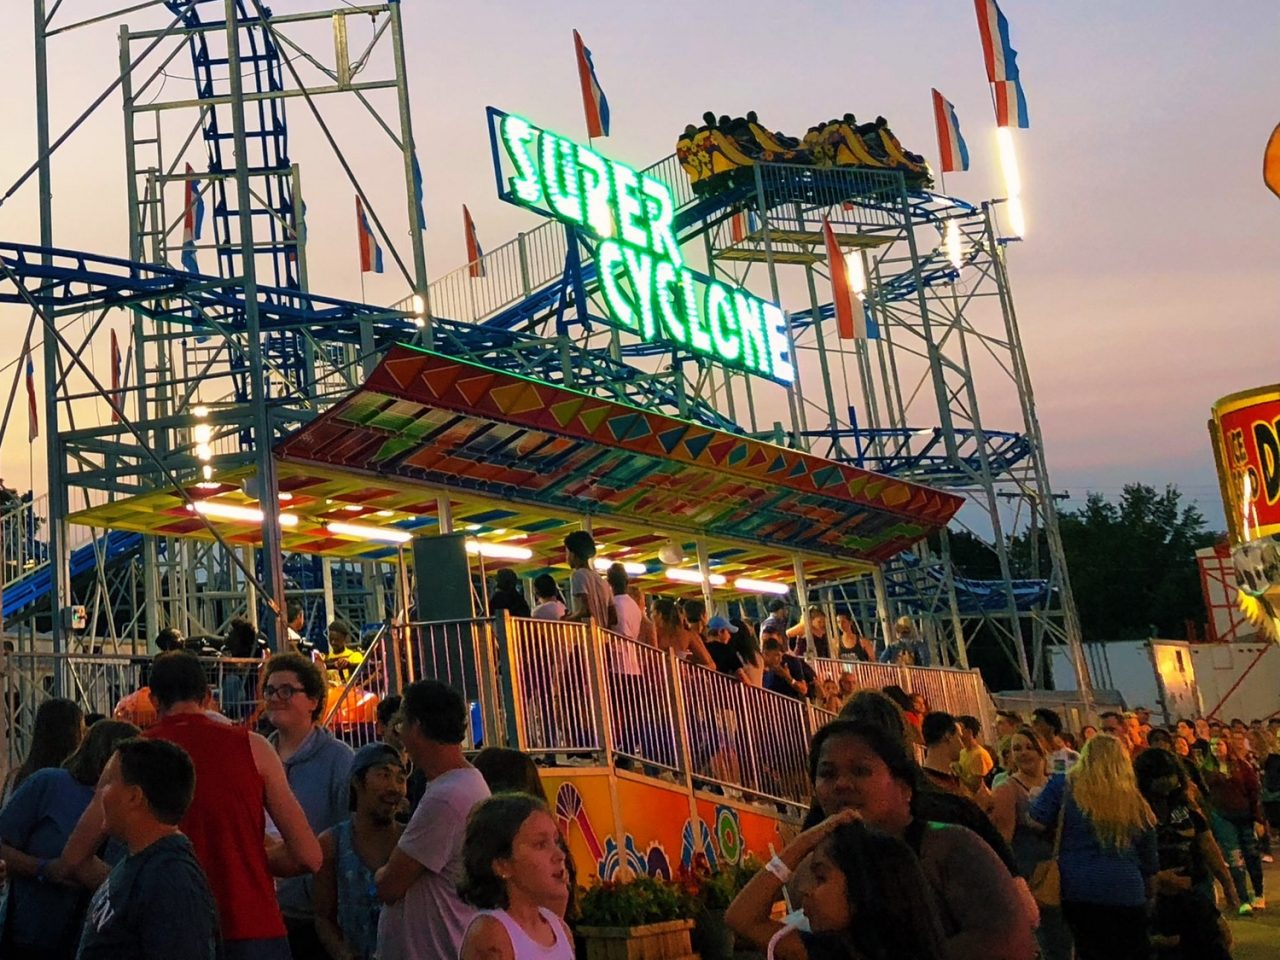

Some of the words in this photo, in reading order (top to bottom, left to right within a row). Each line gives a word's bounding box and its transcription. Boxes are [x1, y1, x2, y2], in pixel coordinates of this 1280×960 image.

[500, 113, 685, 269] SUPER
[597, 239, 796, 383] CYCLONE
[1251, 416, 1280, 506] D
